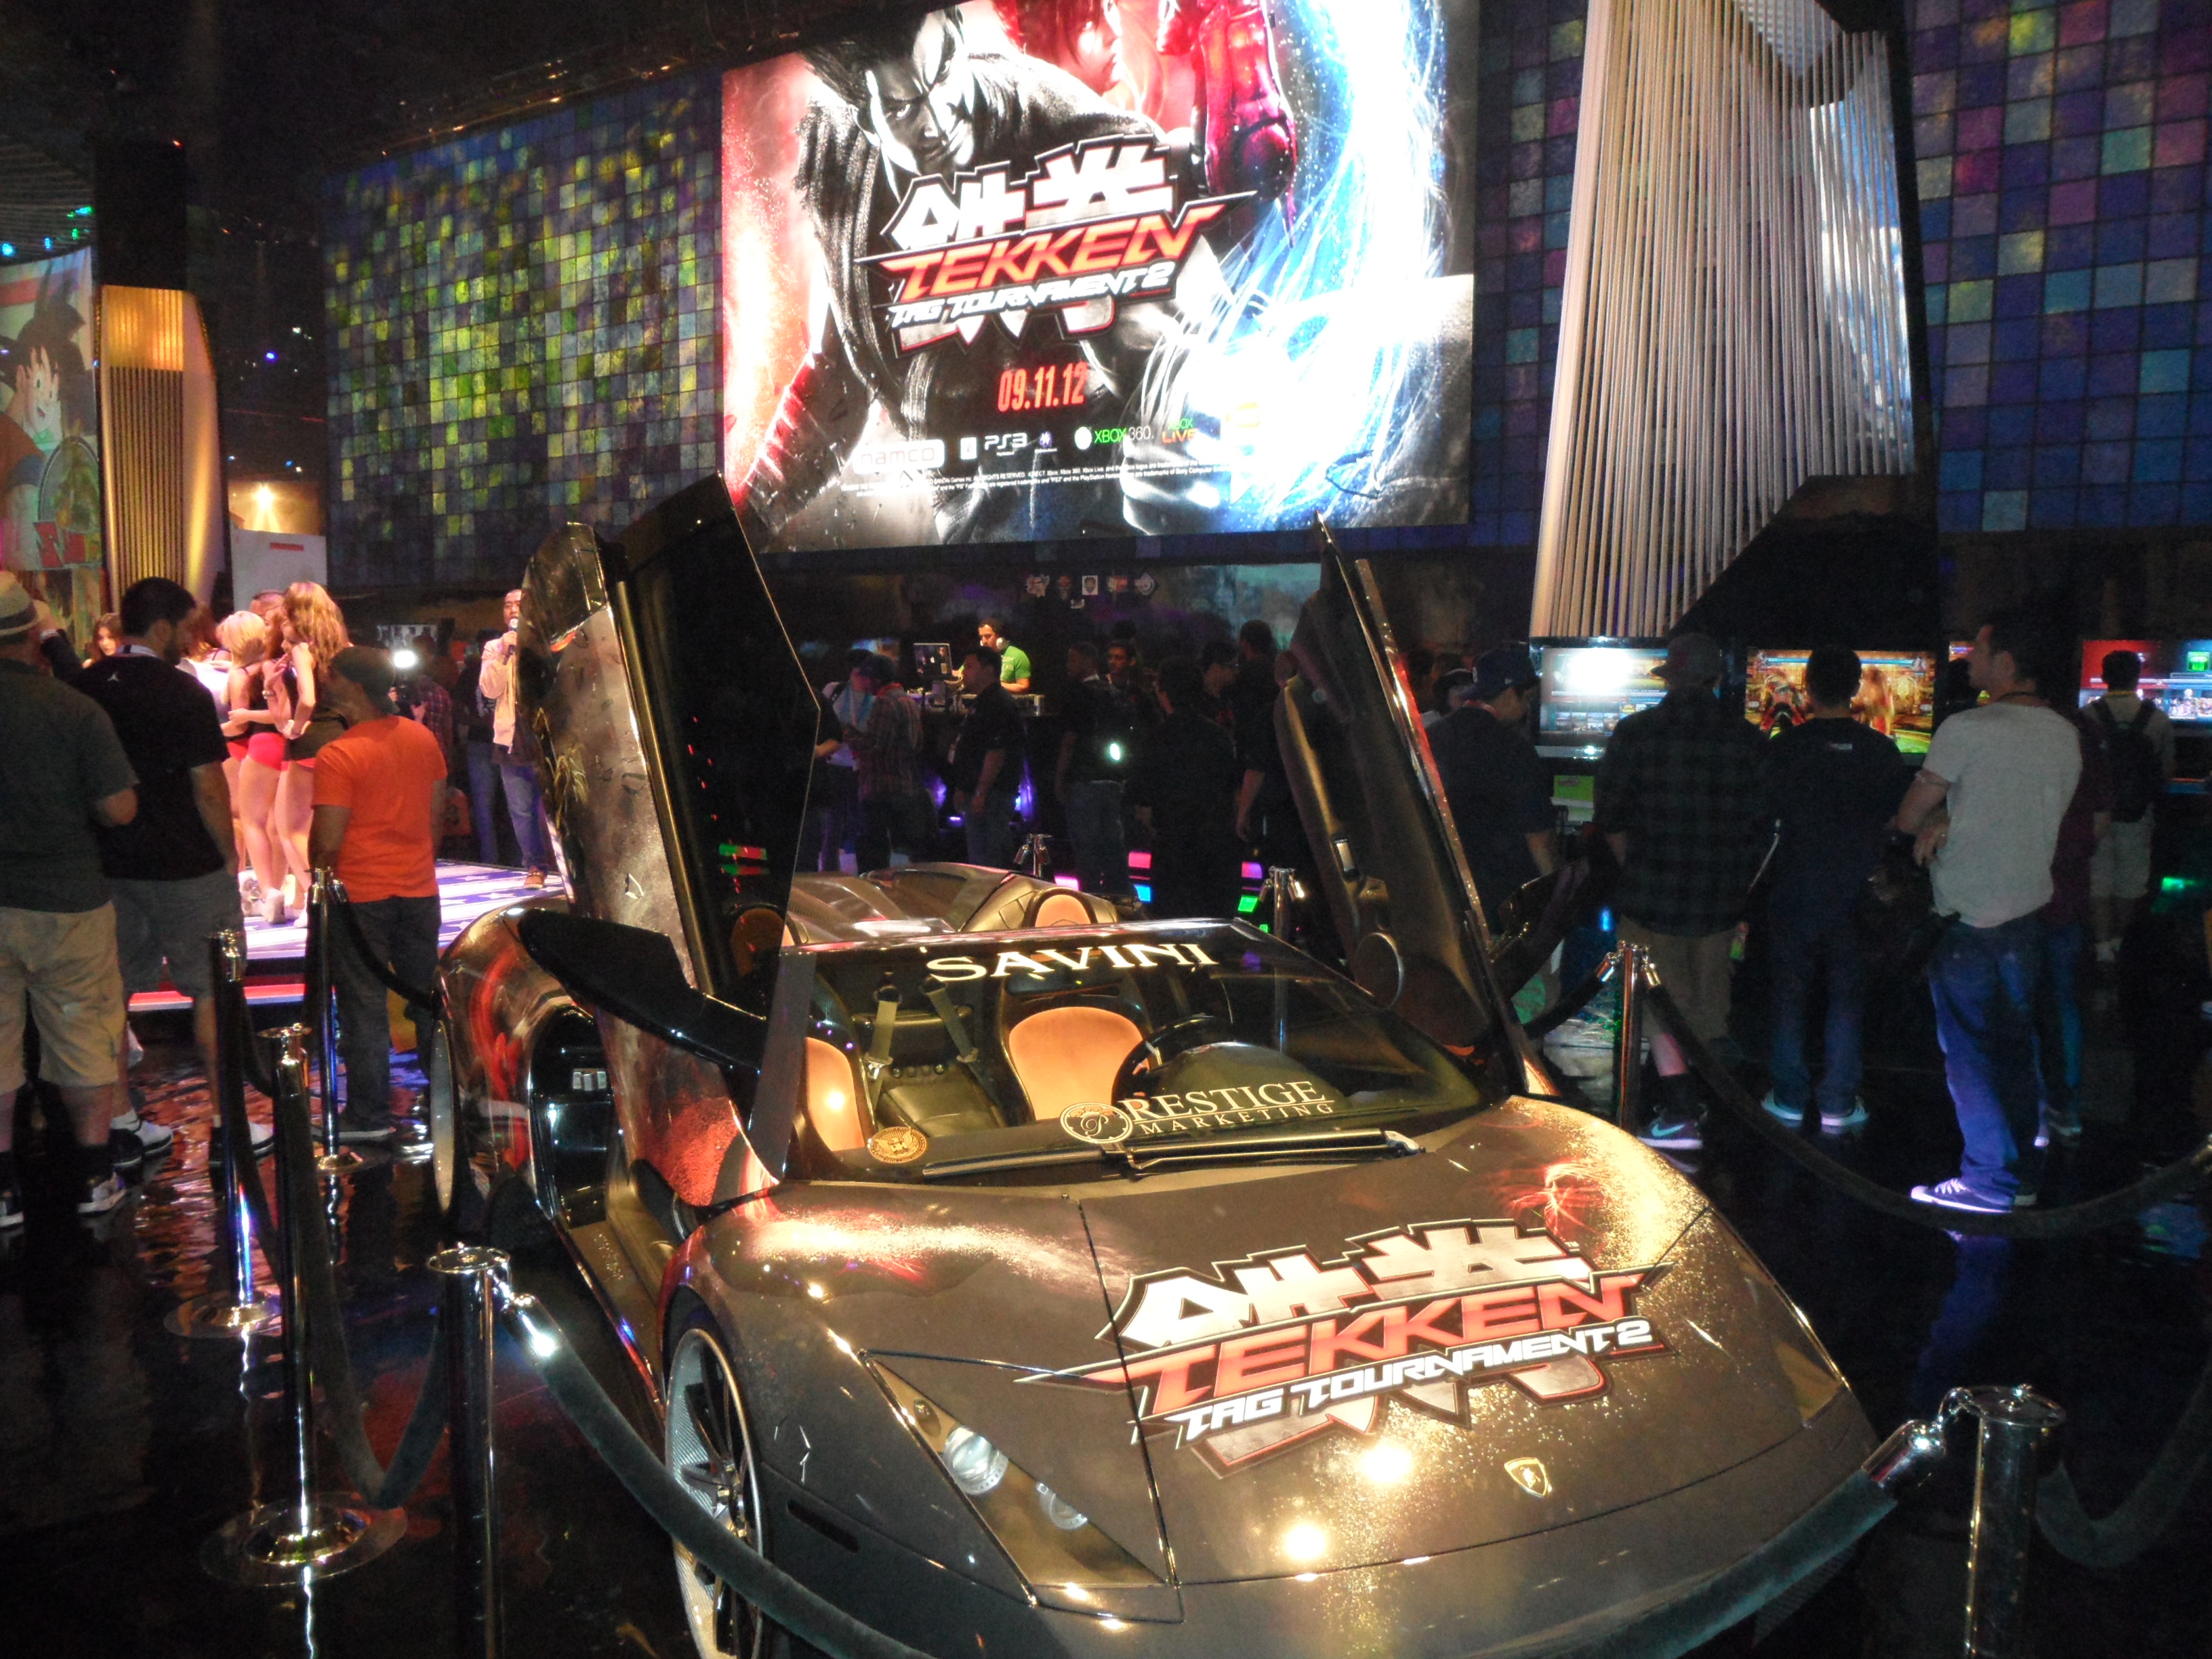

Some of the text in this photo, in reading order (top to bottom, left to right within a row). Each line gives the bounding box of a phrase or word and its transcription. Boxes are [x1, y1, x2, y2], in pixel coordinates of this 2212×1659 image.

[881, 204, 1225, 301] TEKKEN
[887, 299, 943, 329] TAG
[998, 361, 1088, 412] 09.11.12
[985, 432, 1027, 451] PS3
[1094, 428, 1128, 444] XBOX
[1162, 428, 1197, 443] LIVE
[861, 447, 935, 466] namco
[926, 943, 1218, 983] SAVINI
[1140, 1100, 1334, 1136] MARKETING
[1086, 1273, 1643, 1415] TEKKEN
[1166, 1394, 1281, 1443] TAG
[1290, 1326, 1621, 1410] TOURNAMENT
